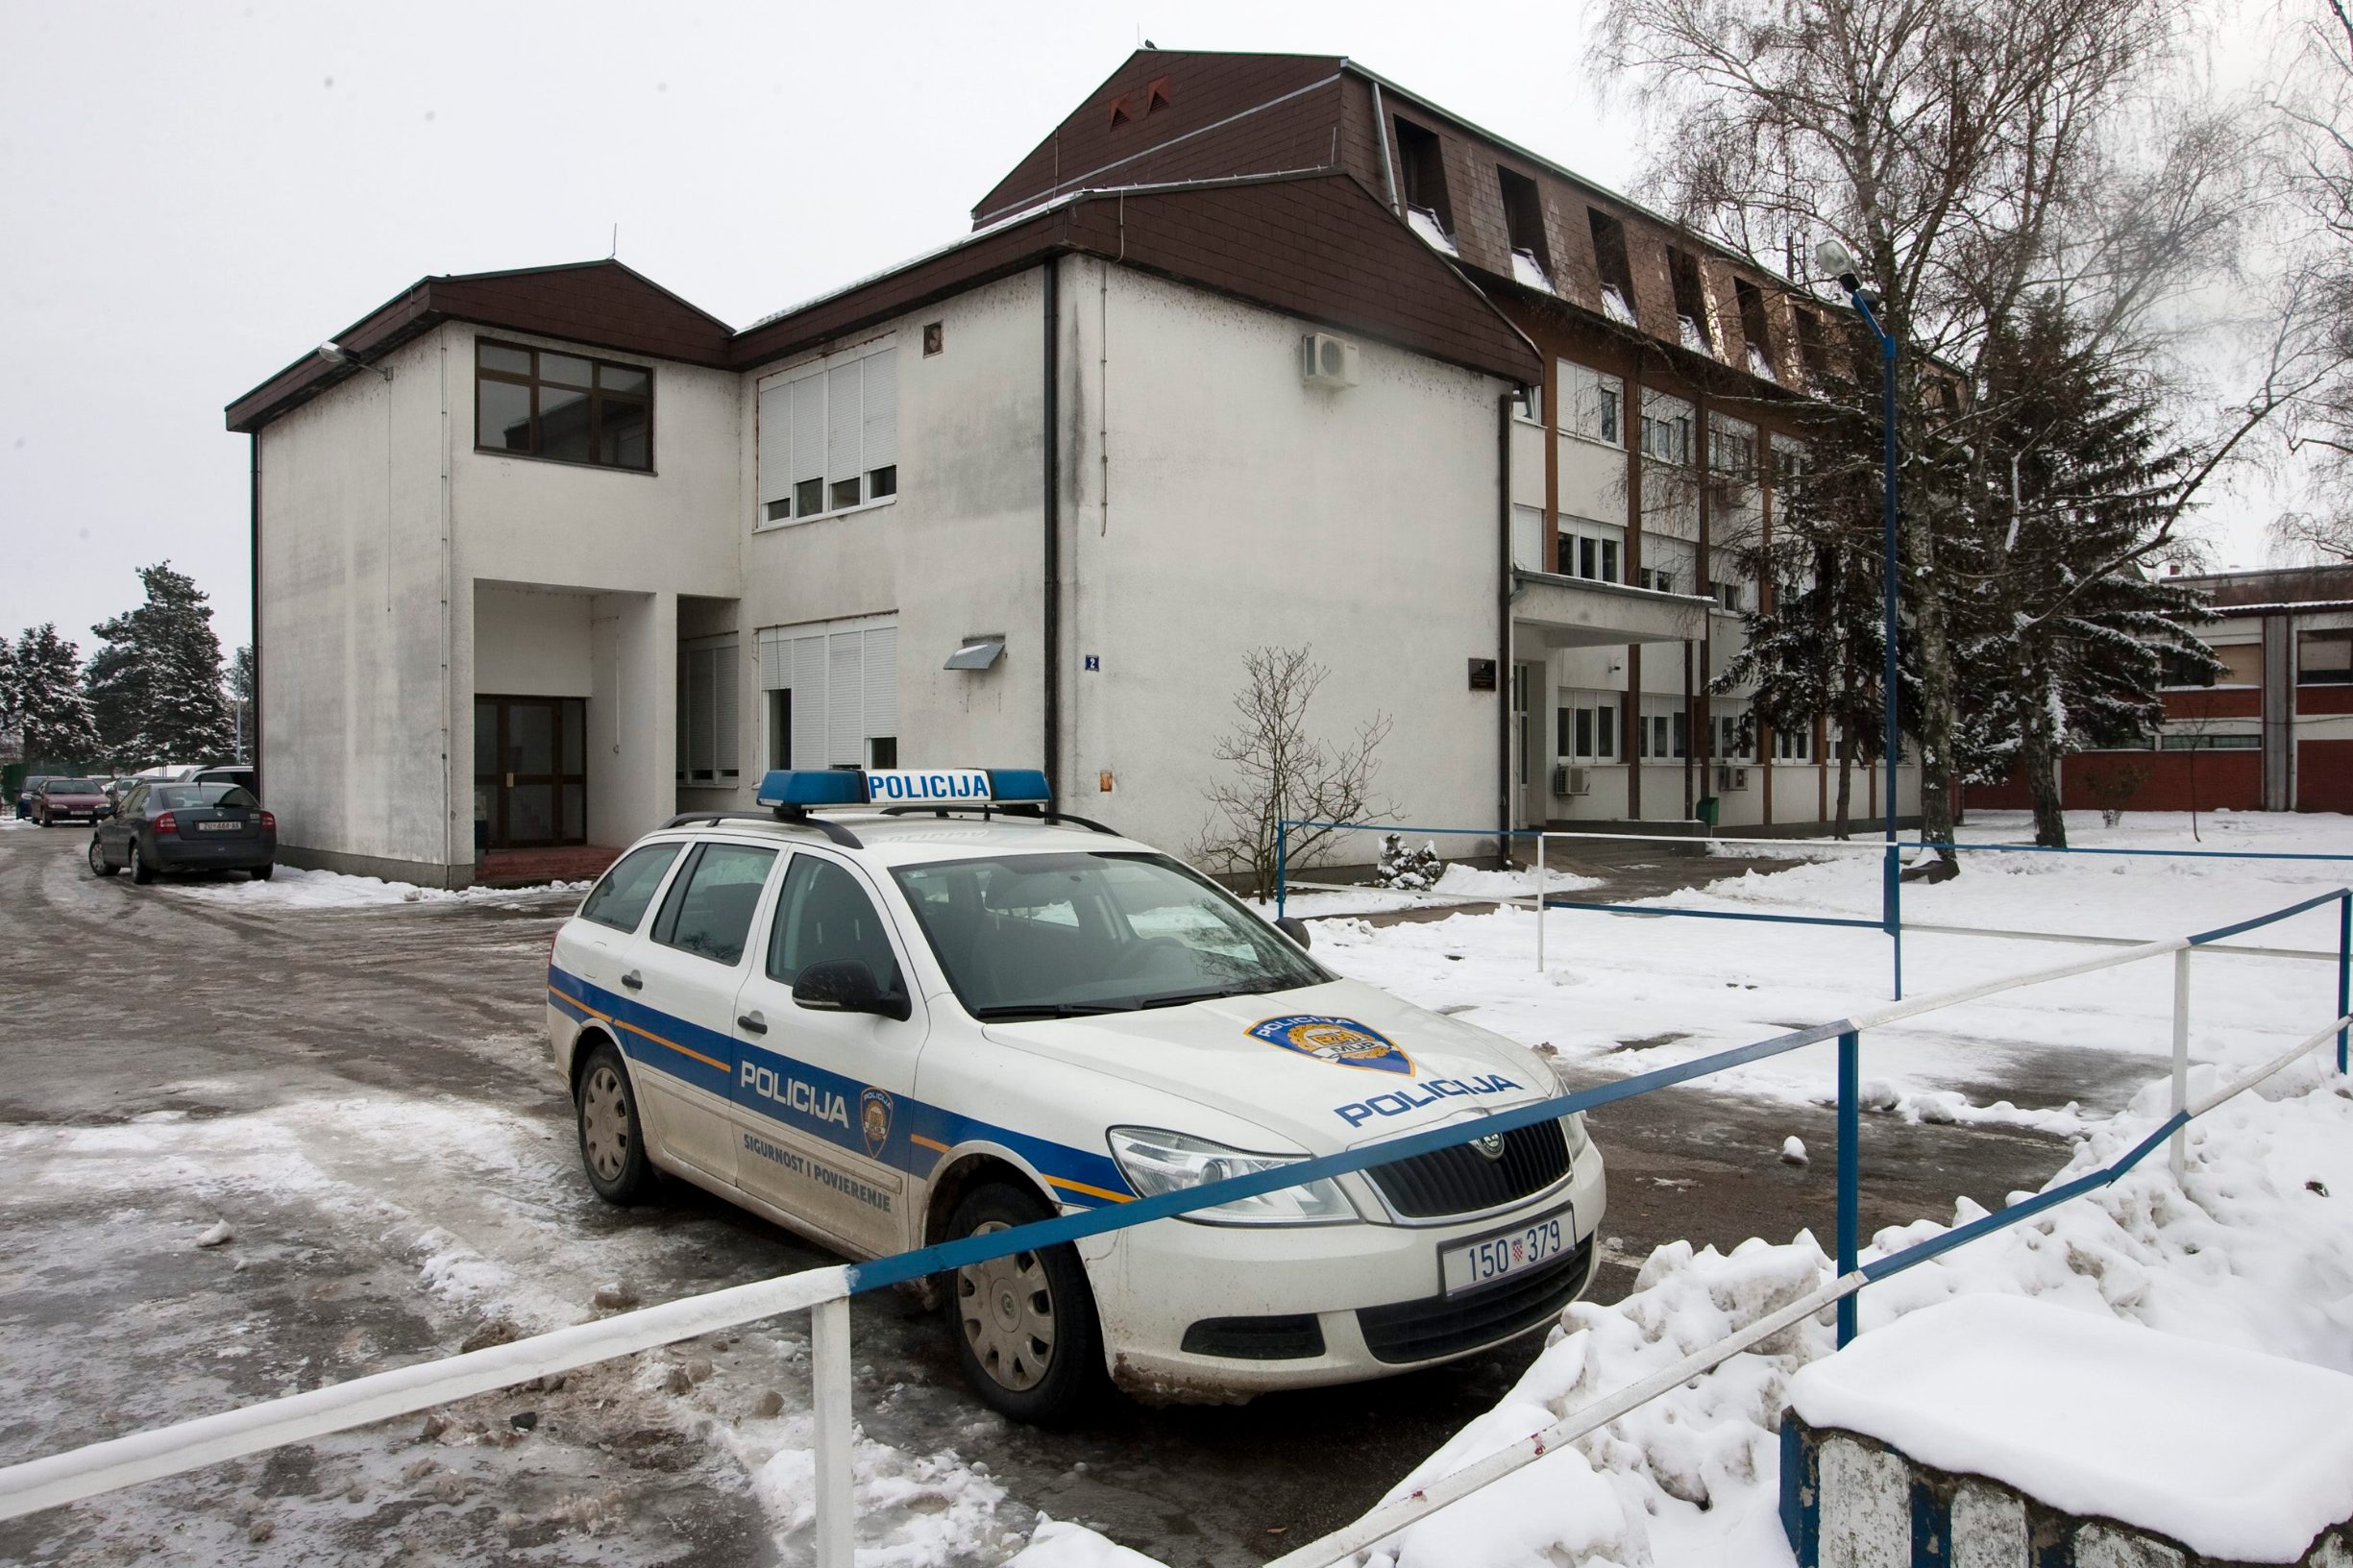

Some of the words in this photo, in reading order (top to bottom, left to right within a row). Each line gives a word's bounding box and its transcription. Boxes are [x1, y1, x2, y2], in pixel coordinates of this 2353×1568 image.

[1090, 657, 1096, 669] 2
[868, 775, 989, 799] POLICIJA
[1257, 1016, 1355, 1038] POLICIJA
[740, 1060, 849, 1129] POLICIJA
[863, 1090, 892, 1110] POLICIJA
[1334, 1074, 1525, 1128] POLICIJA
[744, 1133, 804, 1174] SIGURNOST
[806, 1161, 812, 1177] I
[814, 1164, 892, 1213] POVJERENJE
[1469, 1239, 1508, 1282] 150
[1527, 1219, 1561, 1262] 379
